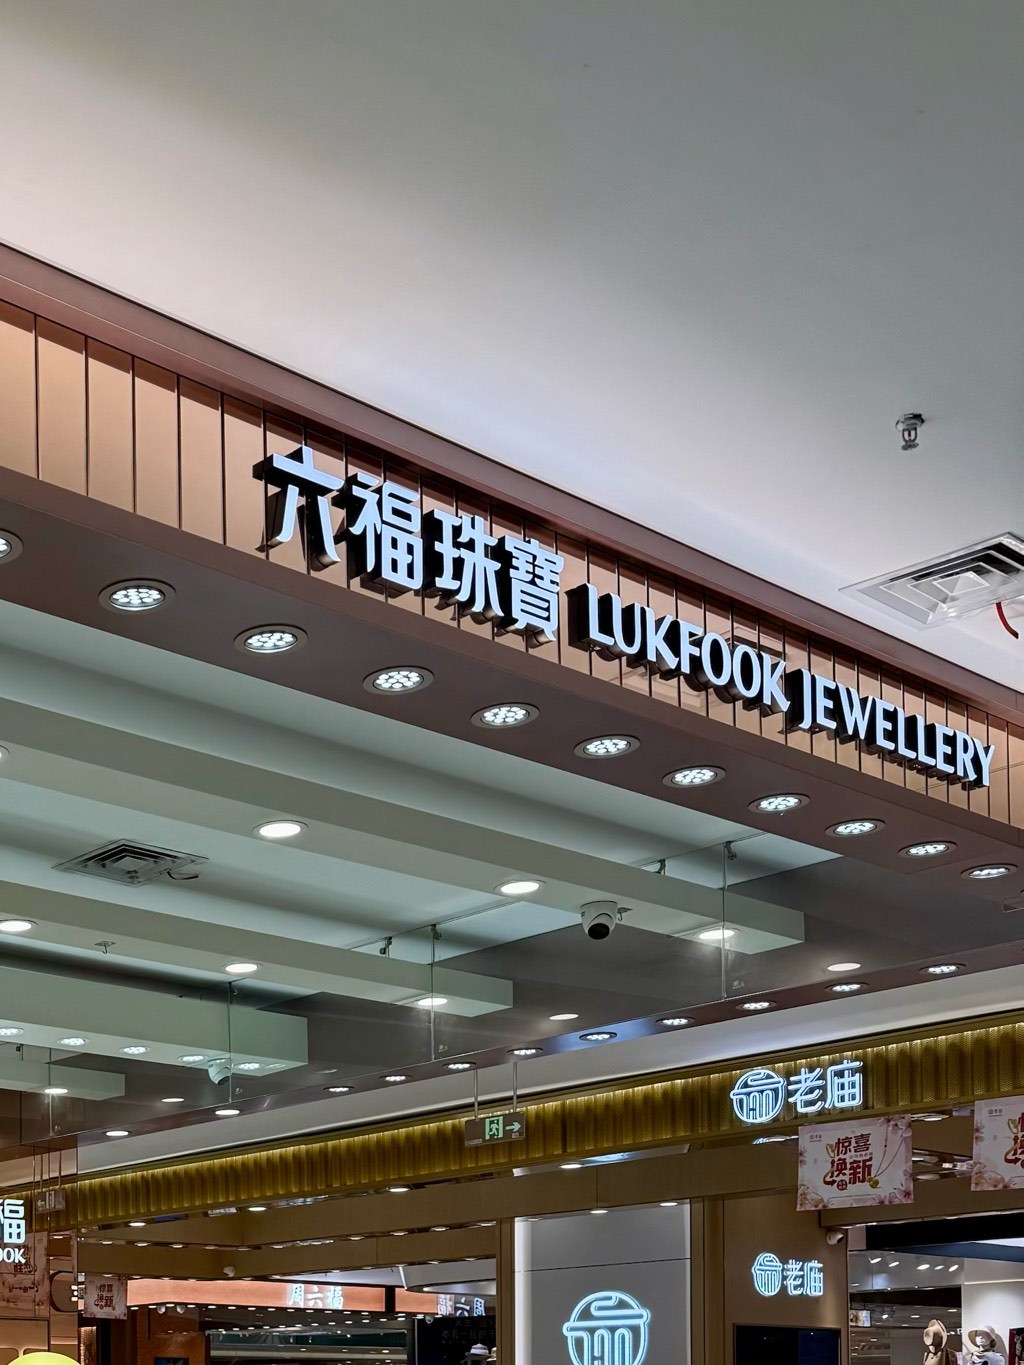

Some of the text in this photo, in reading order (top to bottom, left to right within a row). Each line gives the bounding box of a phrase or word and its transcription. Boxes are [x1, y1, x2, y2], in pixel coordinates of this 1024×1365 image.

[273, 446, 995, 788] 六福珠寶 LUKFOOK JEWELLERY
[787, 1059, 864, 1114] 老庙
[835, 1132, 872, 1157] 惊喜
[783, 1259, 824, 1296] 老庙
[288, 1283, 345, 1310] 周六福
